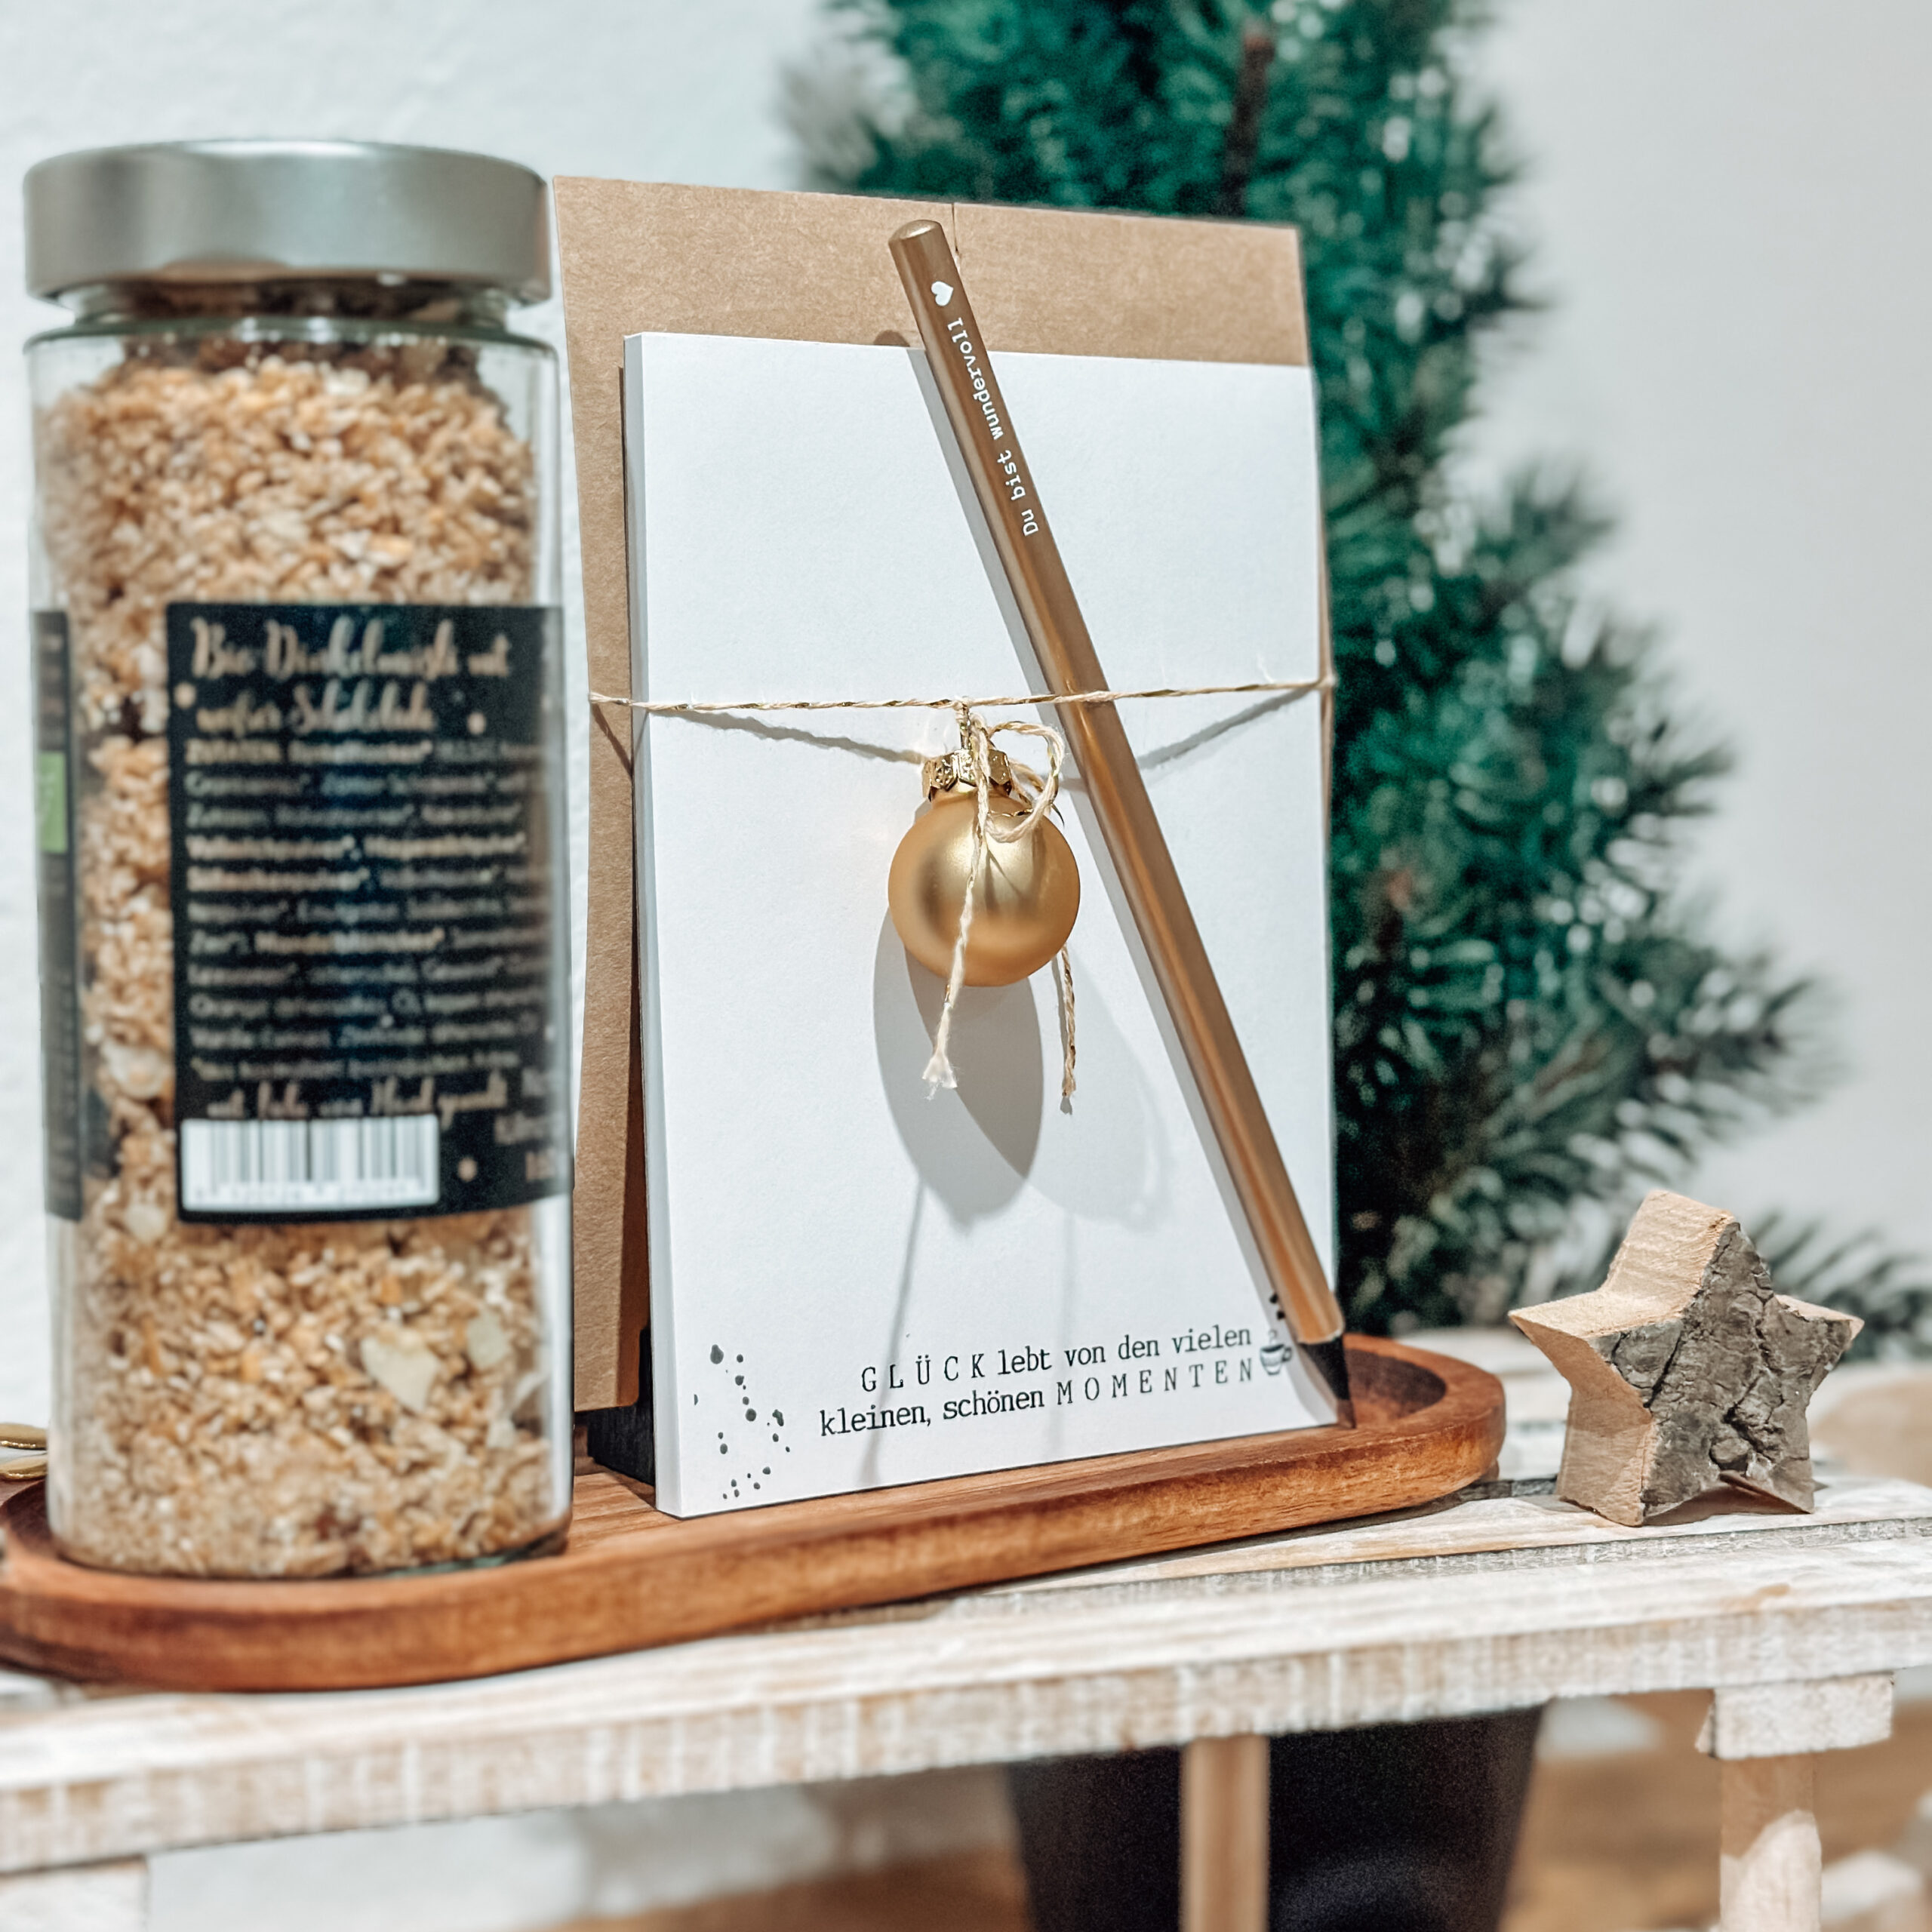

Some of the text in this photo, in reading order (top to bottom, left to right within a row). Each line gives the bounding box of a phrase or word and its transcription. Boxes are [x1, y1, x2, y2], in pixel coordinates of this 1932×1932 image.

[947, 317, 1039, 536] Du bist wundervoll
[819, 1358, 1252, 1437] kleinen, schönen MOMENTEN
[861, 1324, 1252, 1392] GLÜCK lebt von den vielen
